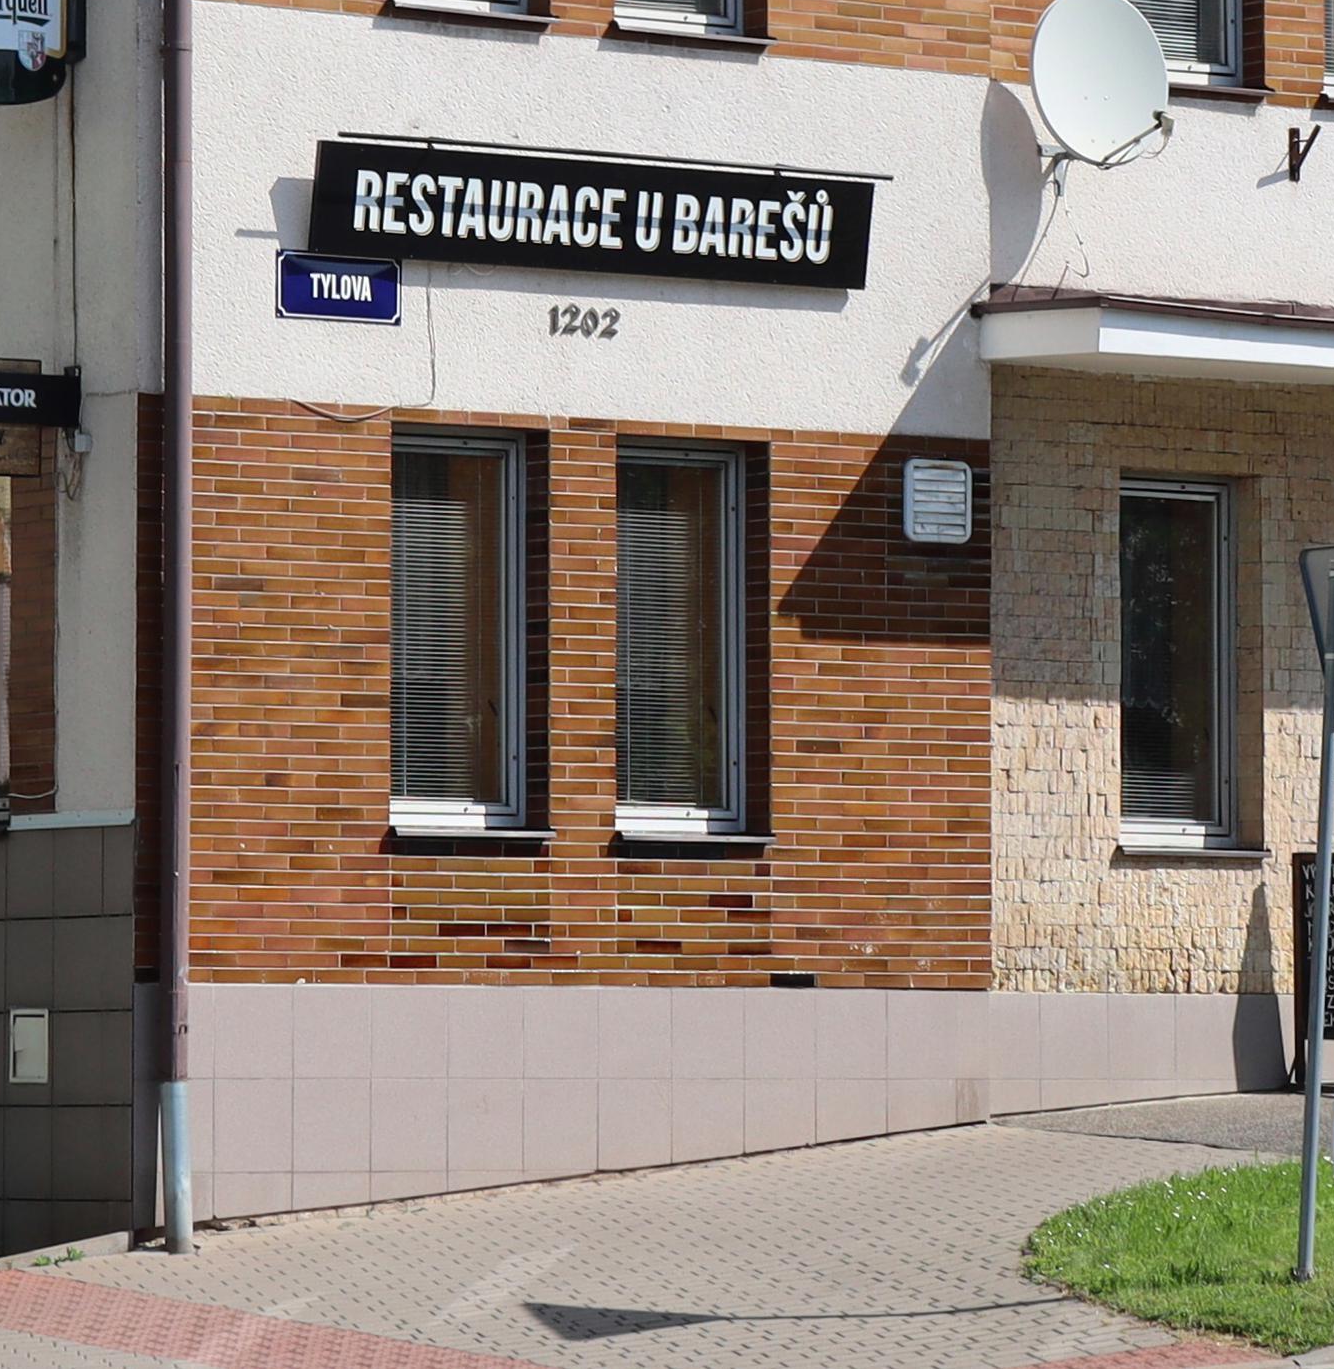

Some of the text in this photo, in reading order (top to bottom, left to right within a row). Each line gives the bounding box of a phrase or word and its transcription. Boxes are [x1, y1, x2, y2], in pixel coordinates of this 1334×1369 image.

[353, 169, 834, 264] RESTAURACE U BAREŠŮ
[310, 272, 372, 302] TYLOVA
[547, 304, 621, 341] 1202
